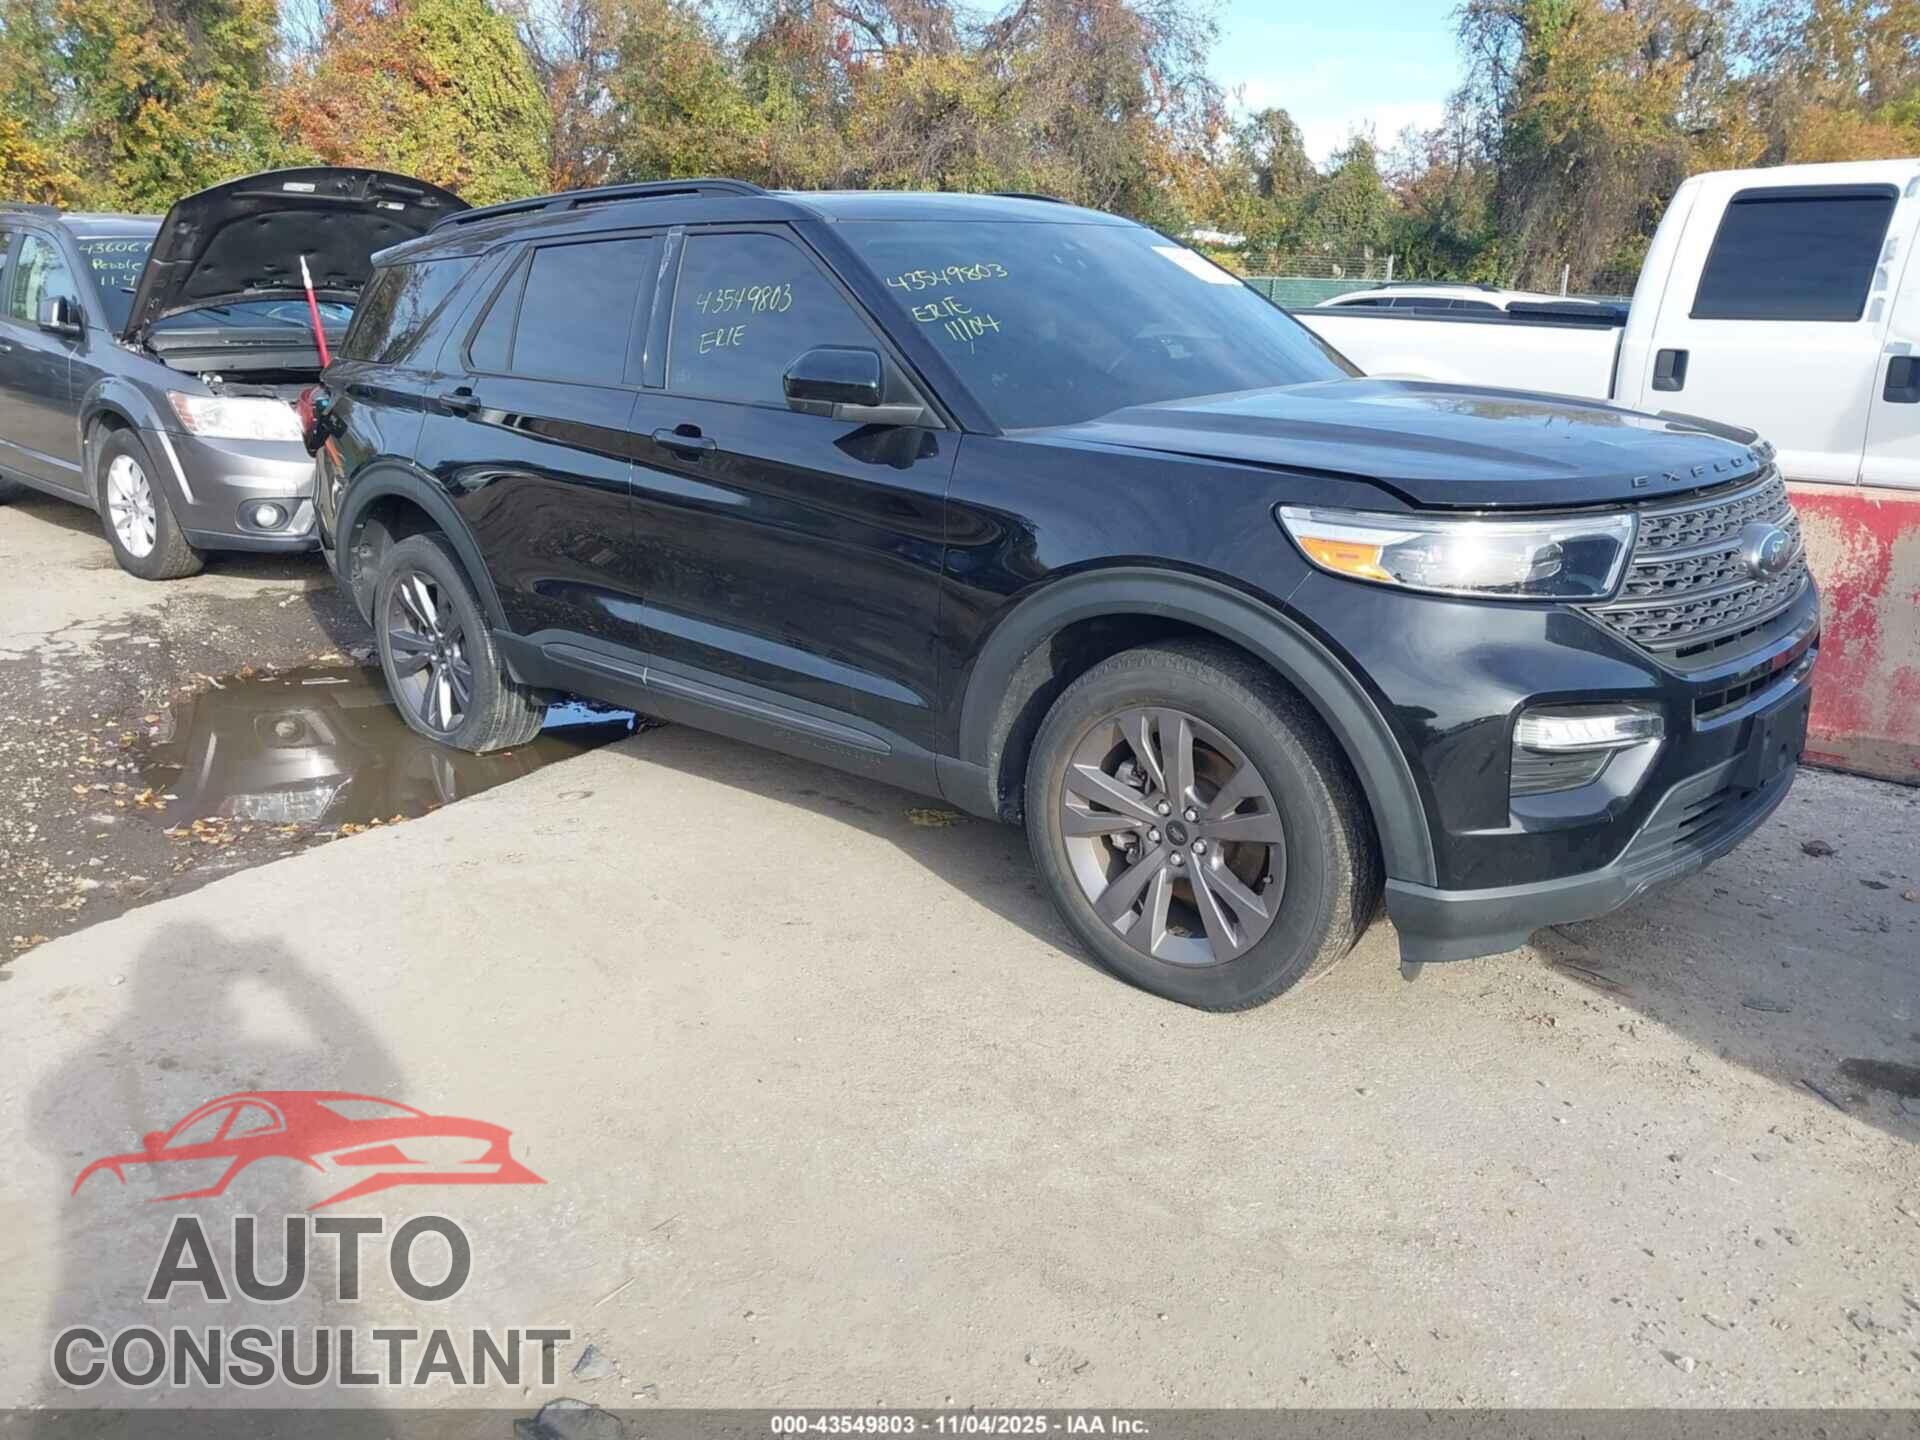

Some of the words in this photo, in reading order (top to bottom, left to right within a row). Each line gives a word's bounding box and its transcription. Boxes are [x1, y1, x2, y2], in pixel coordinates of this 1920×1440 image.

[886, 264, 1008, 292] 43549803
[696, 283, 792, 314] 43549803
[912, 296, 972, 321] ERIE
[699, 325, 747, 354] ERIE
